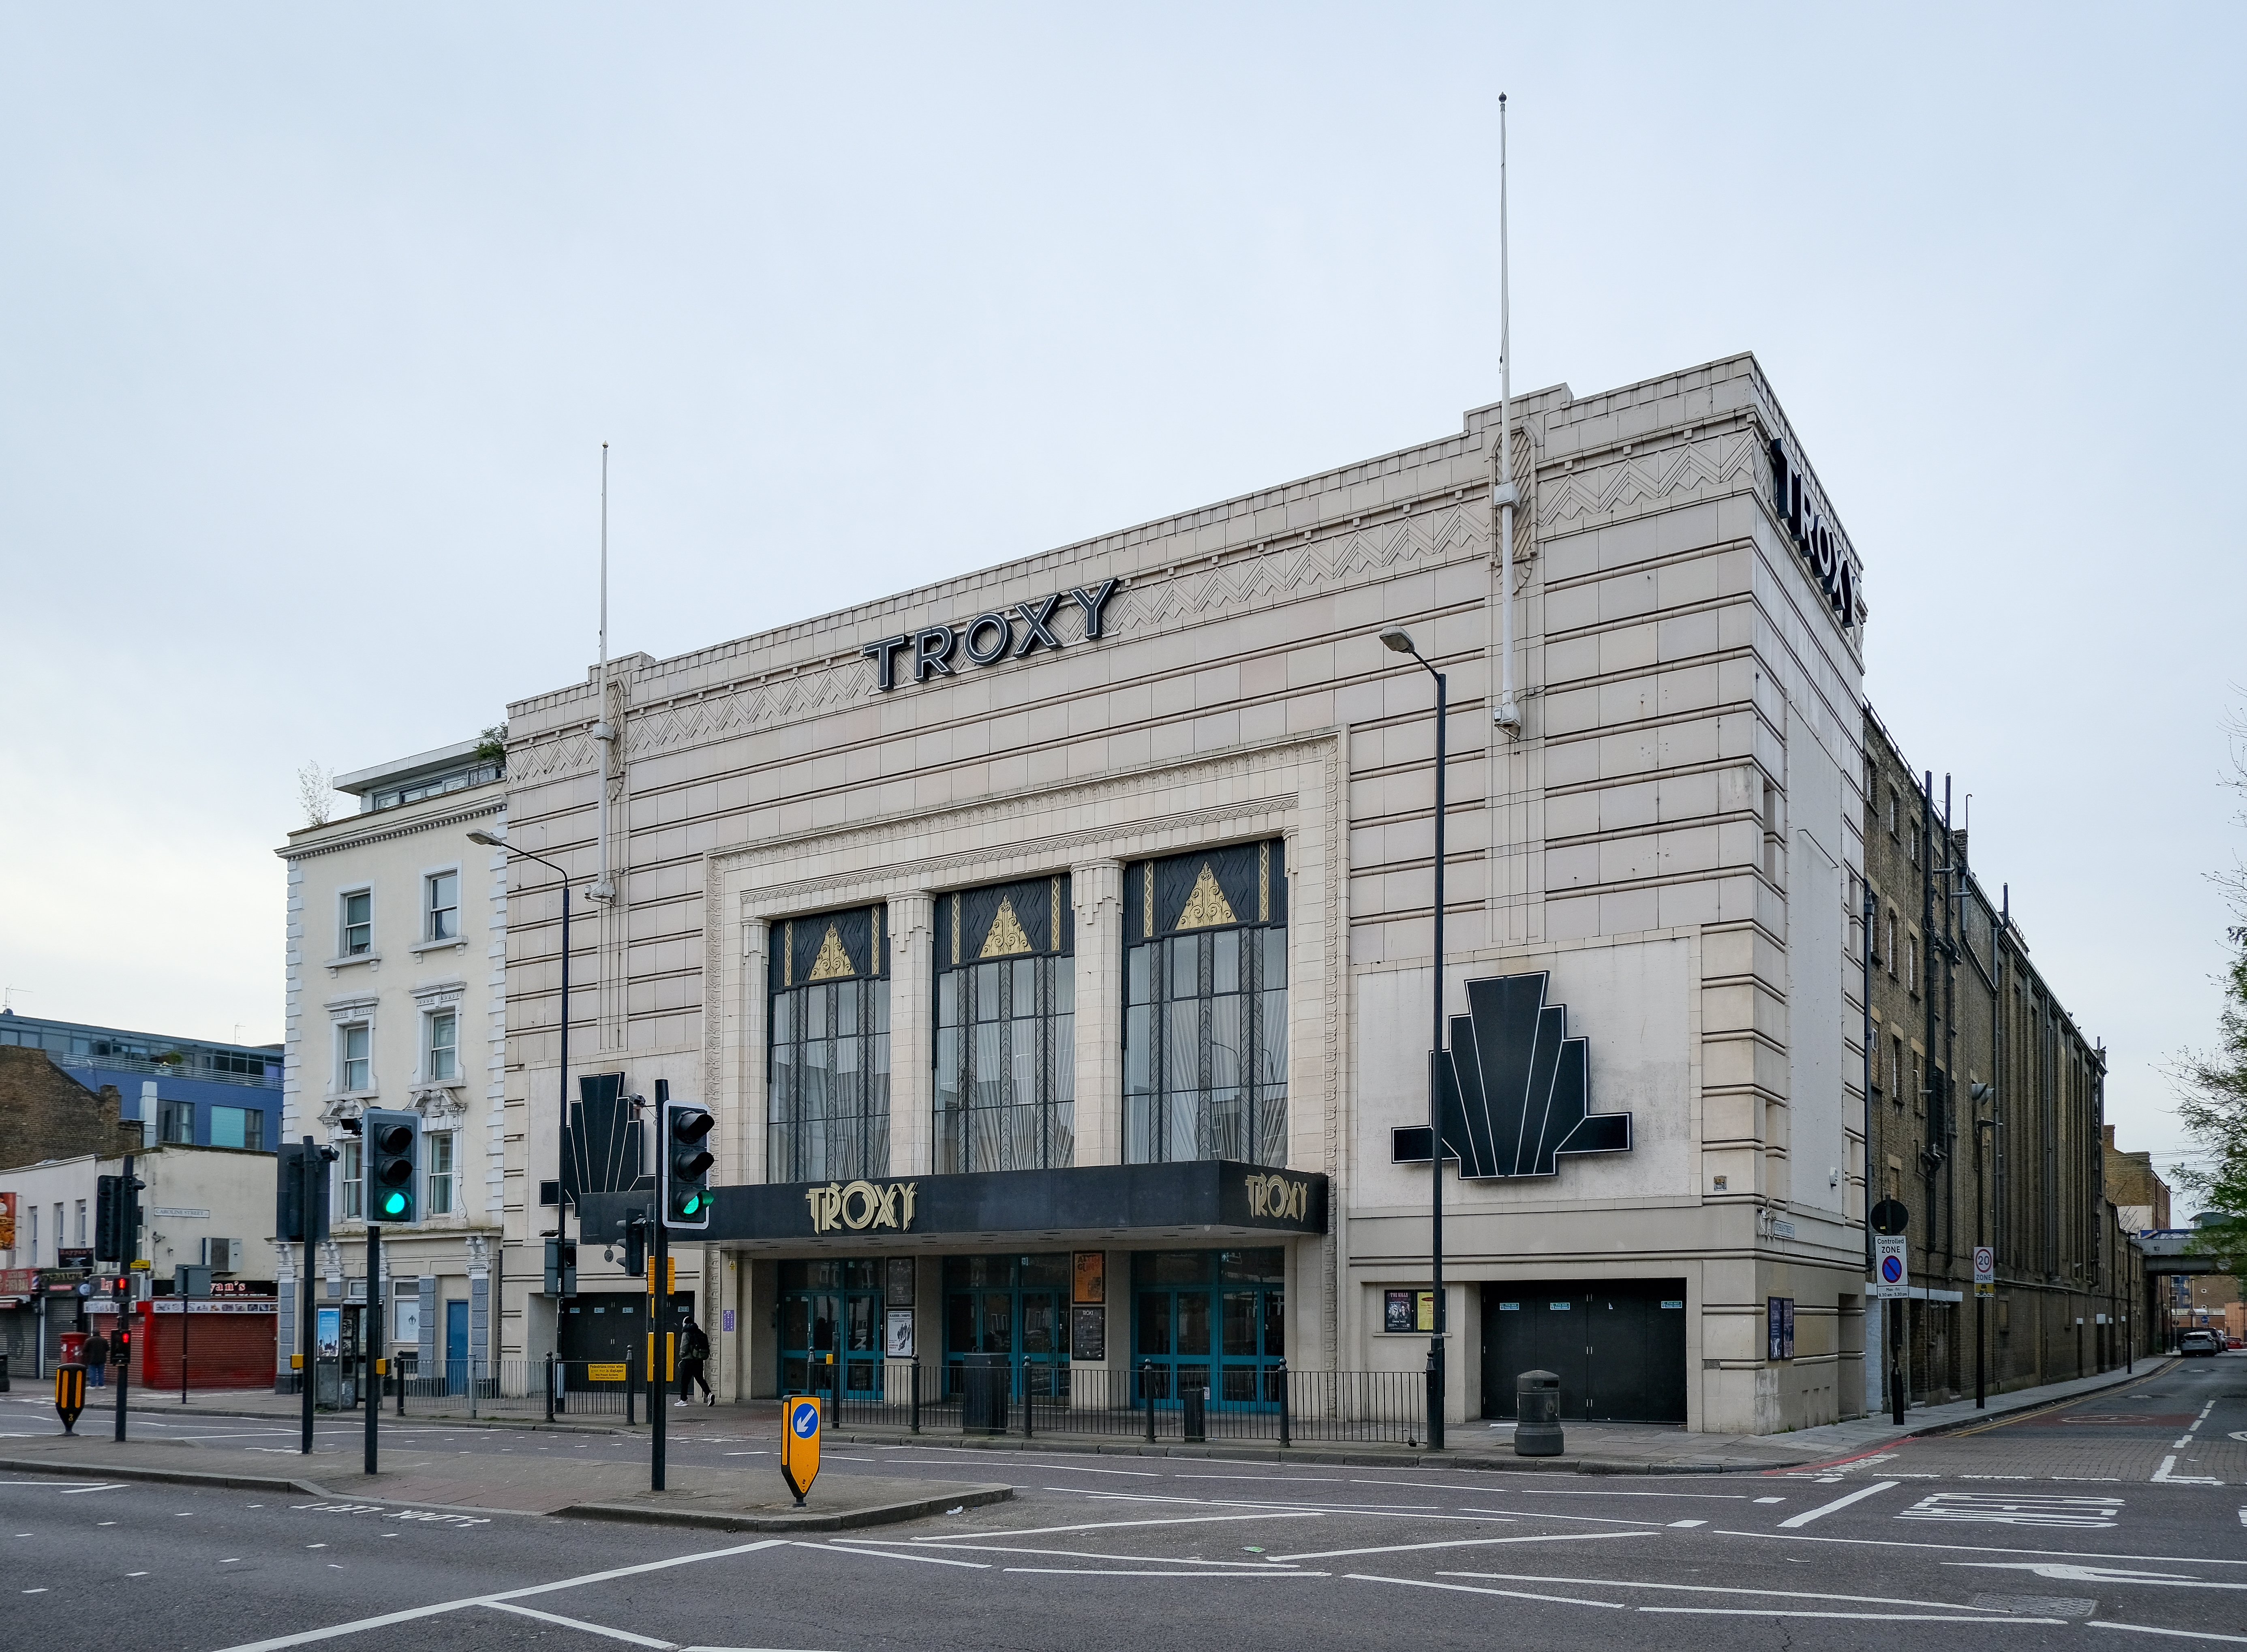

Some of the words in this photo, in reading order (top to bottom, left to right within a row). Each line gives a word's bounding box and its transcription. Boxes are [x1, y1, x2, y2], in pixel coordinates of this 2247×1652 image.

[1770, 438, 1862, 627] TROXY
[863, 577, 1120, 691] TROXY
[805, 1180, 918, 1235] TROXY
[1245, 1172, 1307, 1222] TROXY
[1978, 1256, 1990, 1265] 20
